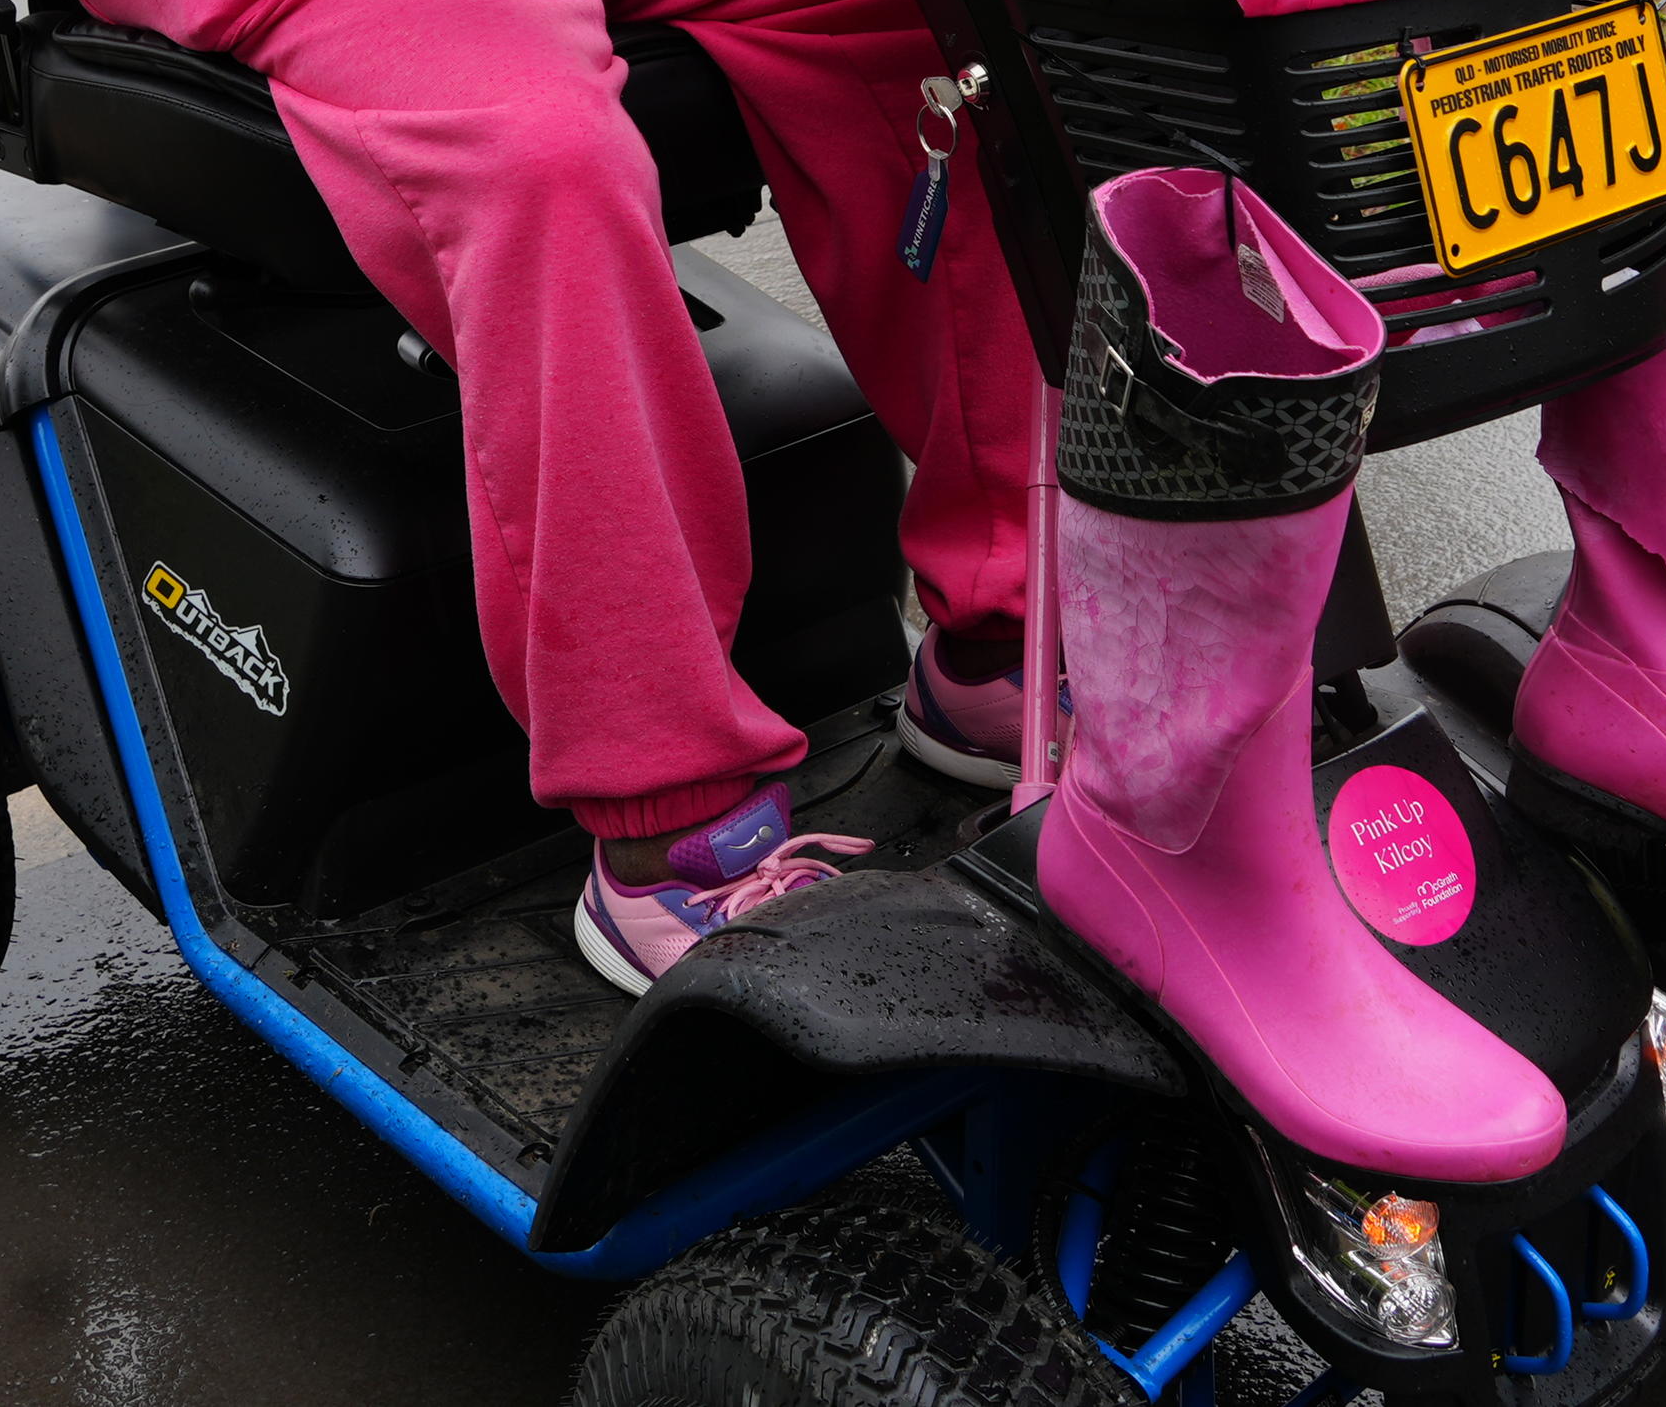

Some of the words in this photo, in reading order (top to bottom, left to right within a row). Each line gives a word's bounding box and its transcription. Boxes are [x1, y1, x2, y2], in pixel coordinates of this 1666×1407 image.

[1430, 78, 1513, 118] PEDESTRIAN
[1515, 62, 1566, 94] TRAFFIC
[1568, 48, 1614, 78] ROUTES
[1615, 34, 1647, 61] ONLY
[1455, 64, 1475, 85] QLD
[1483, 45, 1540, 77] MOTORISED
[1540, 31, 1584, 61] MOBILITY
[1586, 19, 1618, 46] DEVICE
[1448, 62, 1662, 230] C647J
[913, 180, 938, 247] KINETICARE
[146, 567, 283, 698] OUTBACK
[1350, 810, 1398, 846] Pink
[1393, 799, 1426, 825] Up
[1373, 834, 1434, 875] Kilcoy
[1417, 872, 1459, 896] McGrath
[1421, 883, 1464, 909] Foundation
